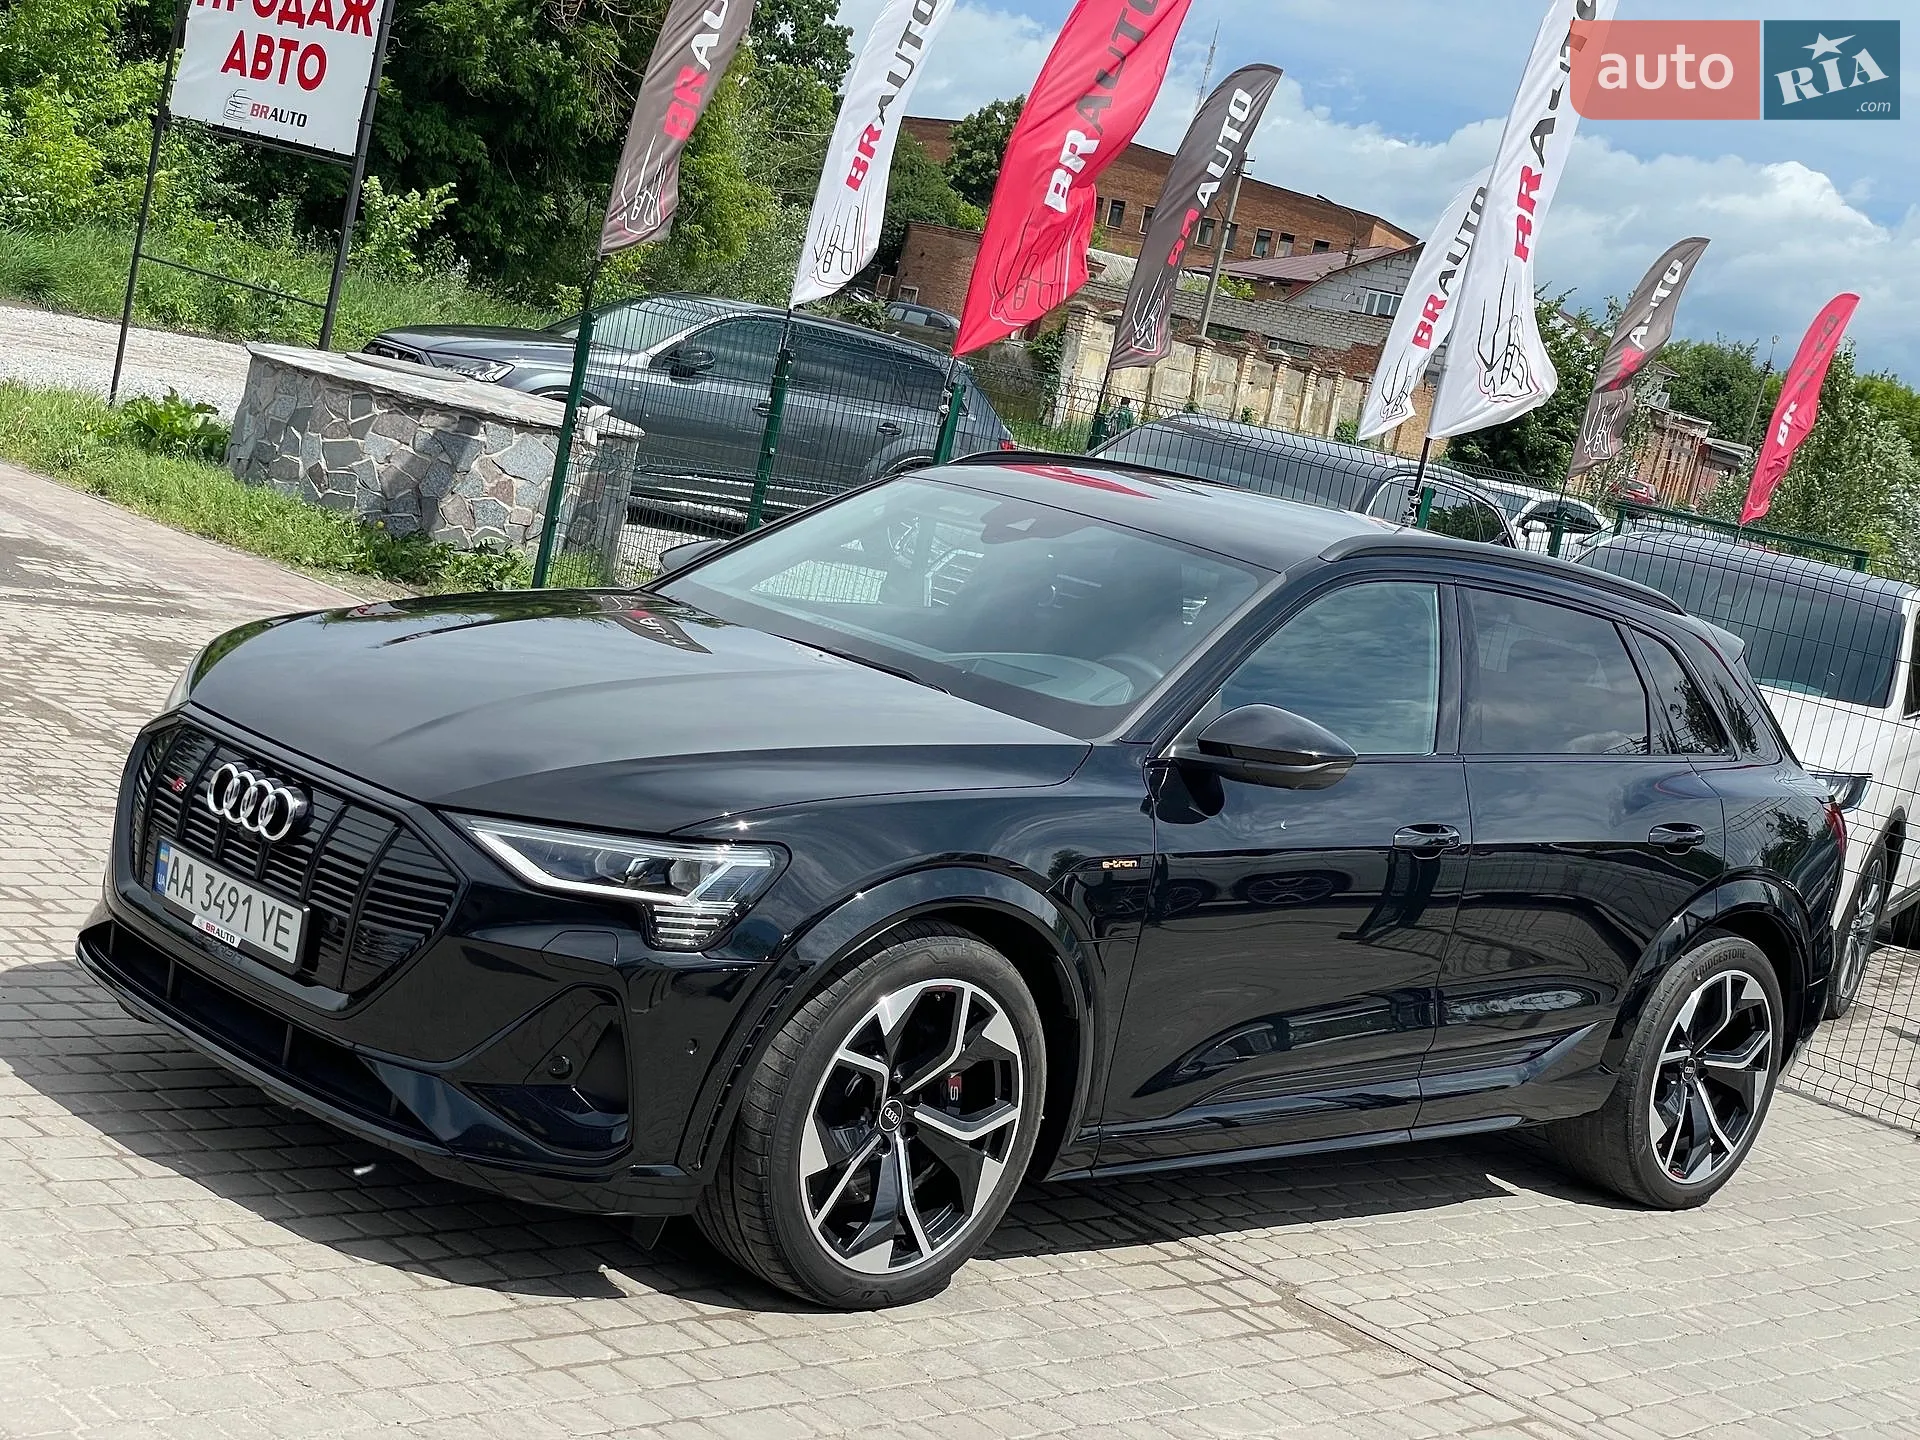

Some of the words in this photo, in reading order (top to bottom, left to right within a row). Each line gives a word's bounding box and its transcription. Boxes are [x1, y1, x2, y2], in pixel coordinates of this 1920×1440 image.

[220, 29, 327, 92] АВТО
[249, 102, 308, 128] BRAUTO
[1102, 859, 1138, 869] e-tron
[156, 873, 166, 887] UA
[166, 855, 194, 905] AA
[200, 873, 253, 933] 3491
[262, 900, 294, 953] YE
[205, 921, 236, 945] BRAUTO
